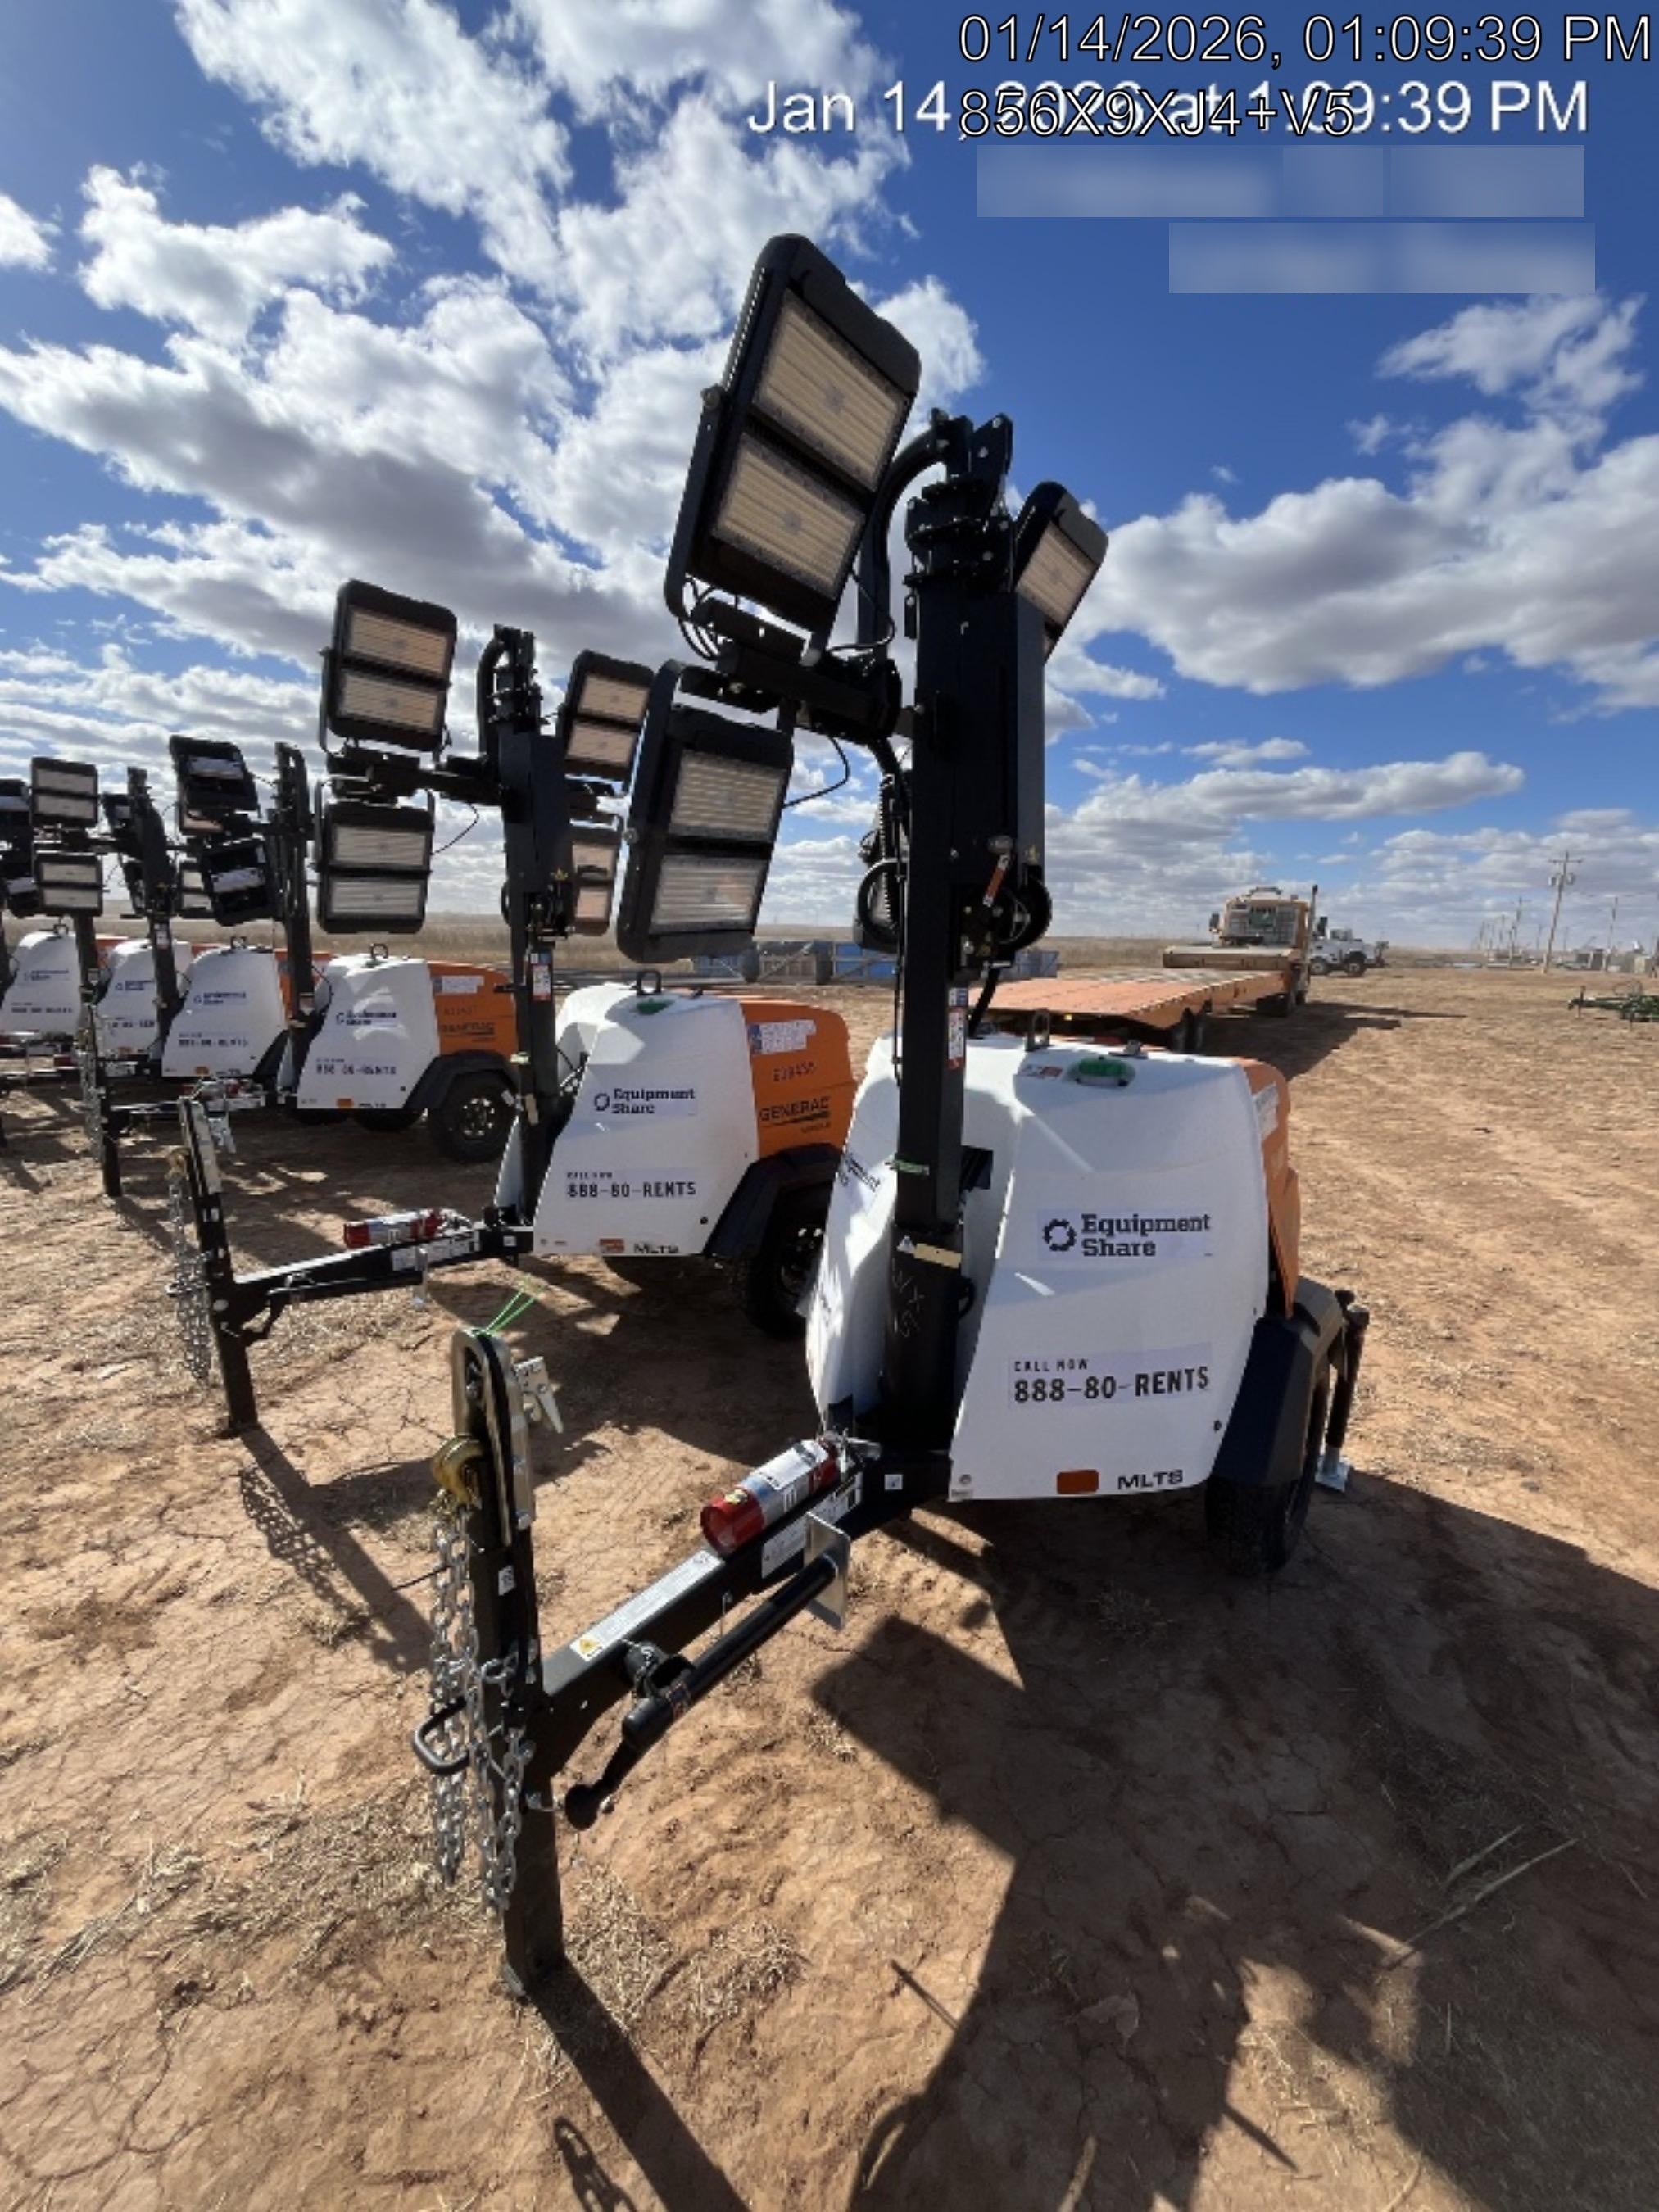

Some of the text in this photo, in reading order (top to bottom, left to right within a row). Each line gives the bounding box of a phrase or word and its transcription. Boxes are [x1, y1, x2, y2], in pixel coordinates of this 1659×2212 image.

[759, 1096, 831, 1122] GENERAC
[1081, 1213, 1211, 1237] Equipment
[1081, 1238, 1157, 1257] Share
[1014, 1358, 1089, 1372] CALL NOW
